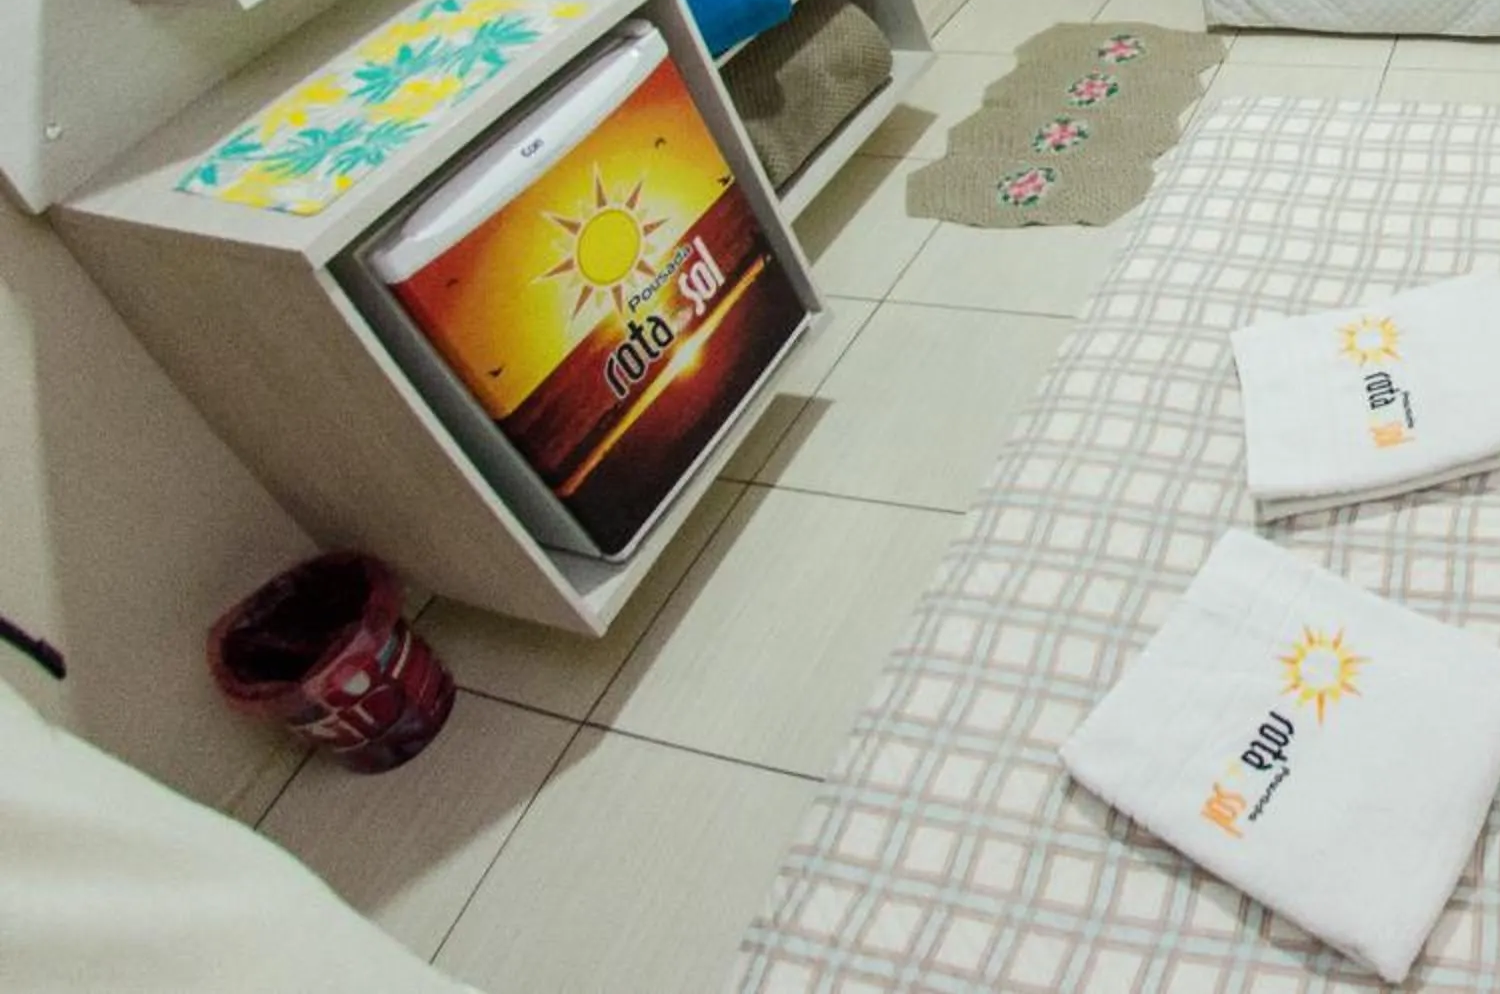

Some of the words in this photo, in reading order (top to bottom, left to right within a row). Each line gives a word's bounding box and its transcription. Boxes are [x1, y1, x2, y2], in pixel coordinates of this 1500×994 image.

[627, 245, 692, 312] Pousada
[606, 315, 675, 397] rota
[678, 235, 725, 316] sol
[1364, 372, 1400, 410] rota
[1241, 711, 1295, 770] rota
